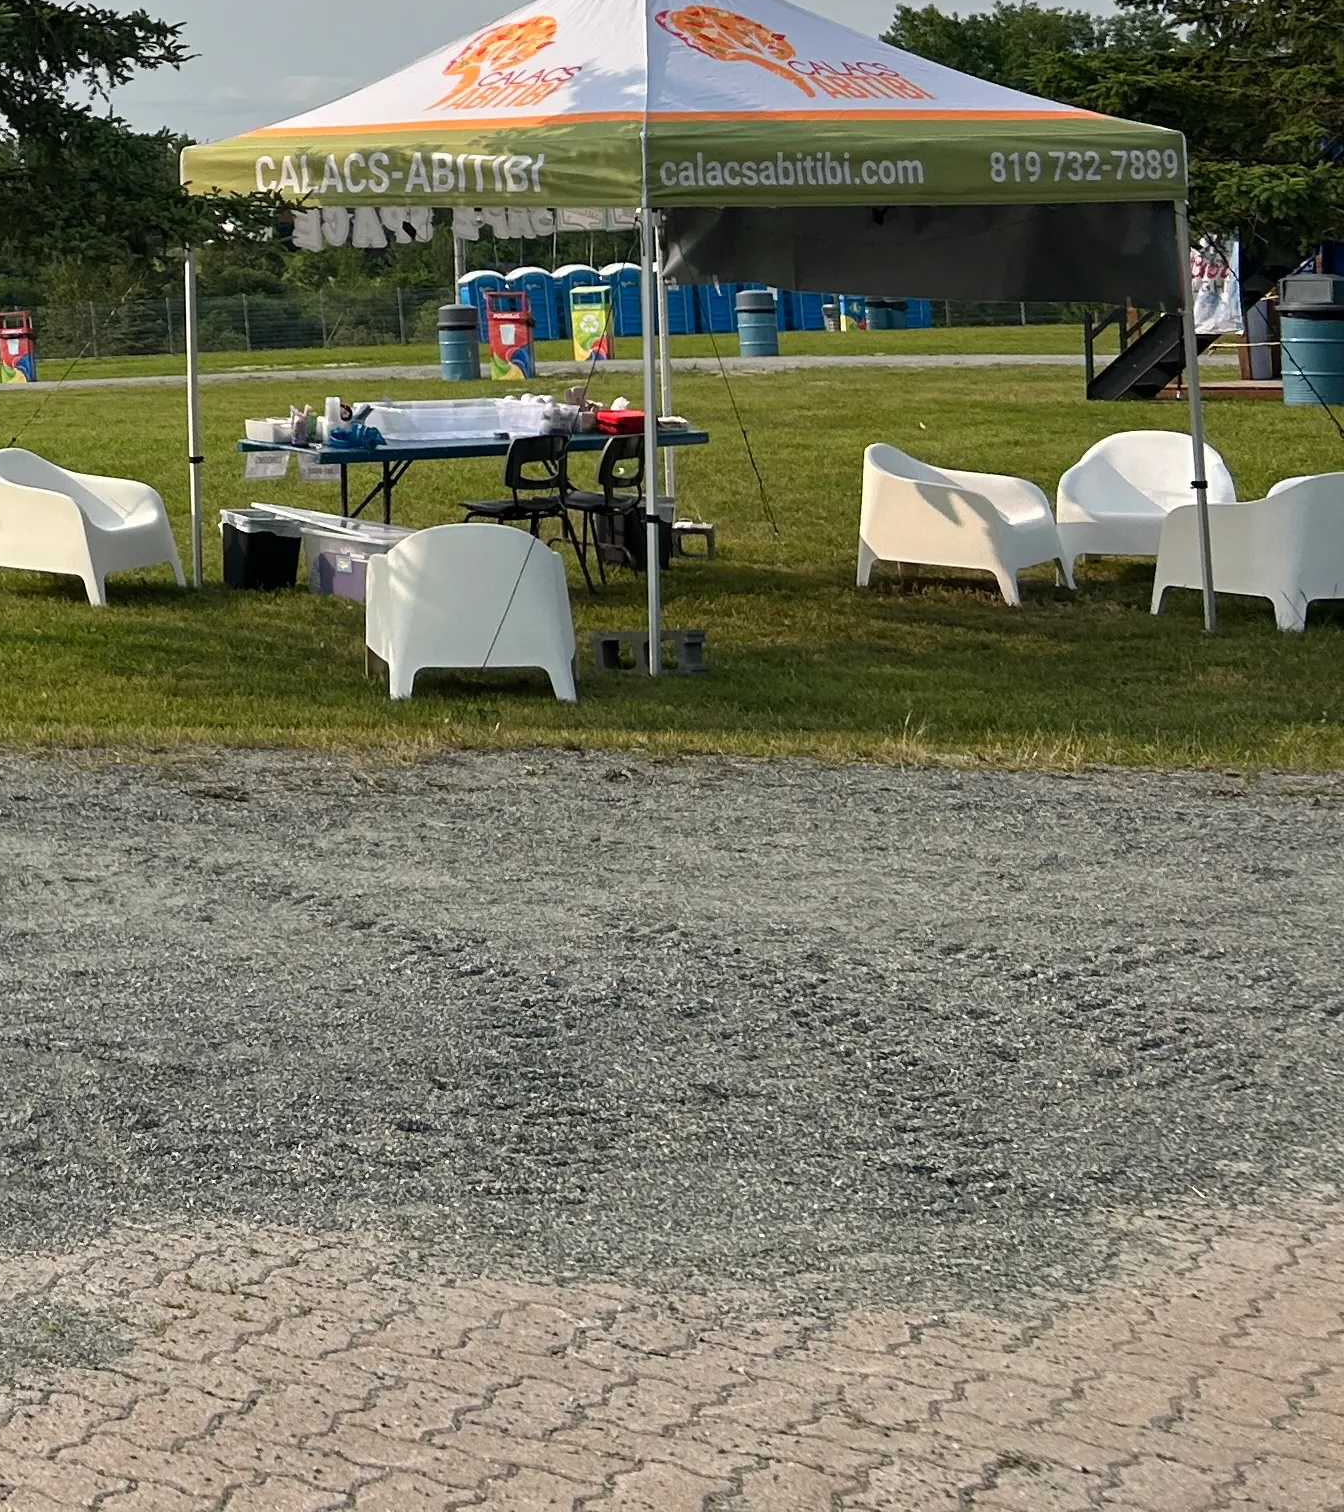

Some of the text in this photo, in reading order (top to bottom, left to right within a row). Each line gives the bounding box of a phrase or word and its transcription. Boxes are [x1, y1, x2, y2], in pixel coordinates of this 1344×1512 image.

[477, 66, 583, 87] CALACS
[787, 60, 900, 78] CALACS
[440, 82, 562, 111] ABITIBI
[807, 75, 937, 100] ABITIBI
[255, 152, 544, 194] CALACS-ABITIBI
[659, 151, 925, 186] calacsabitibi.com
[990, 149, 1178, 183] 819 732-7889
